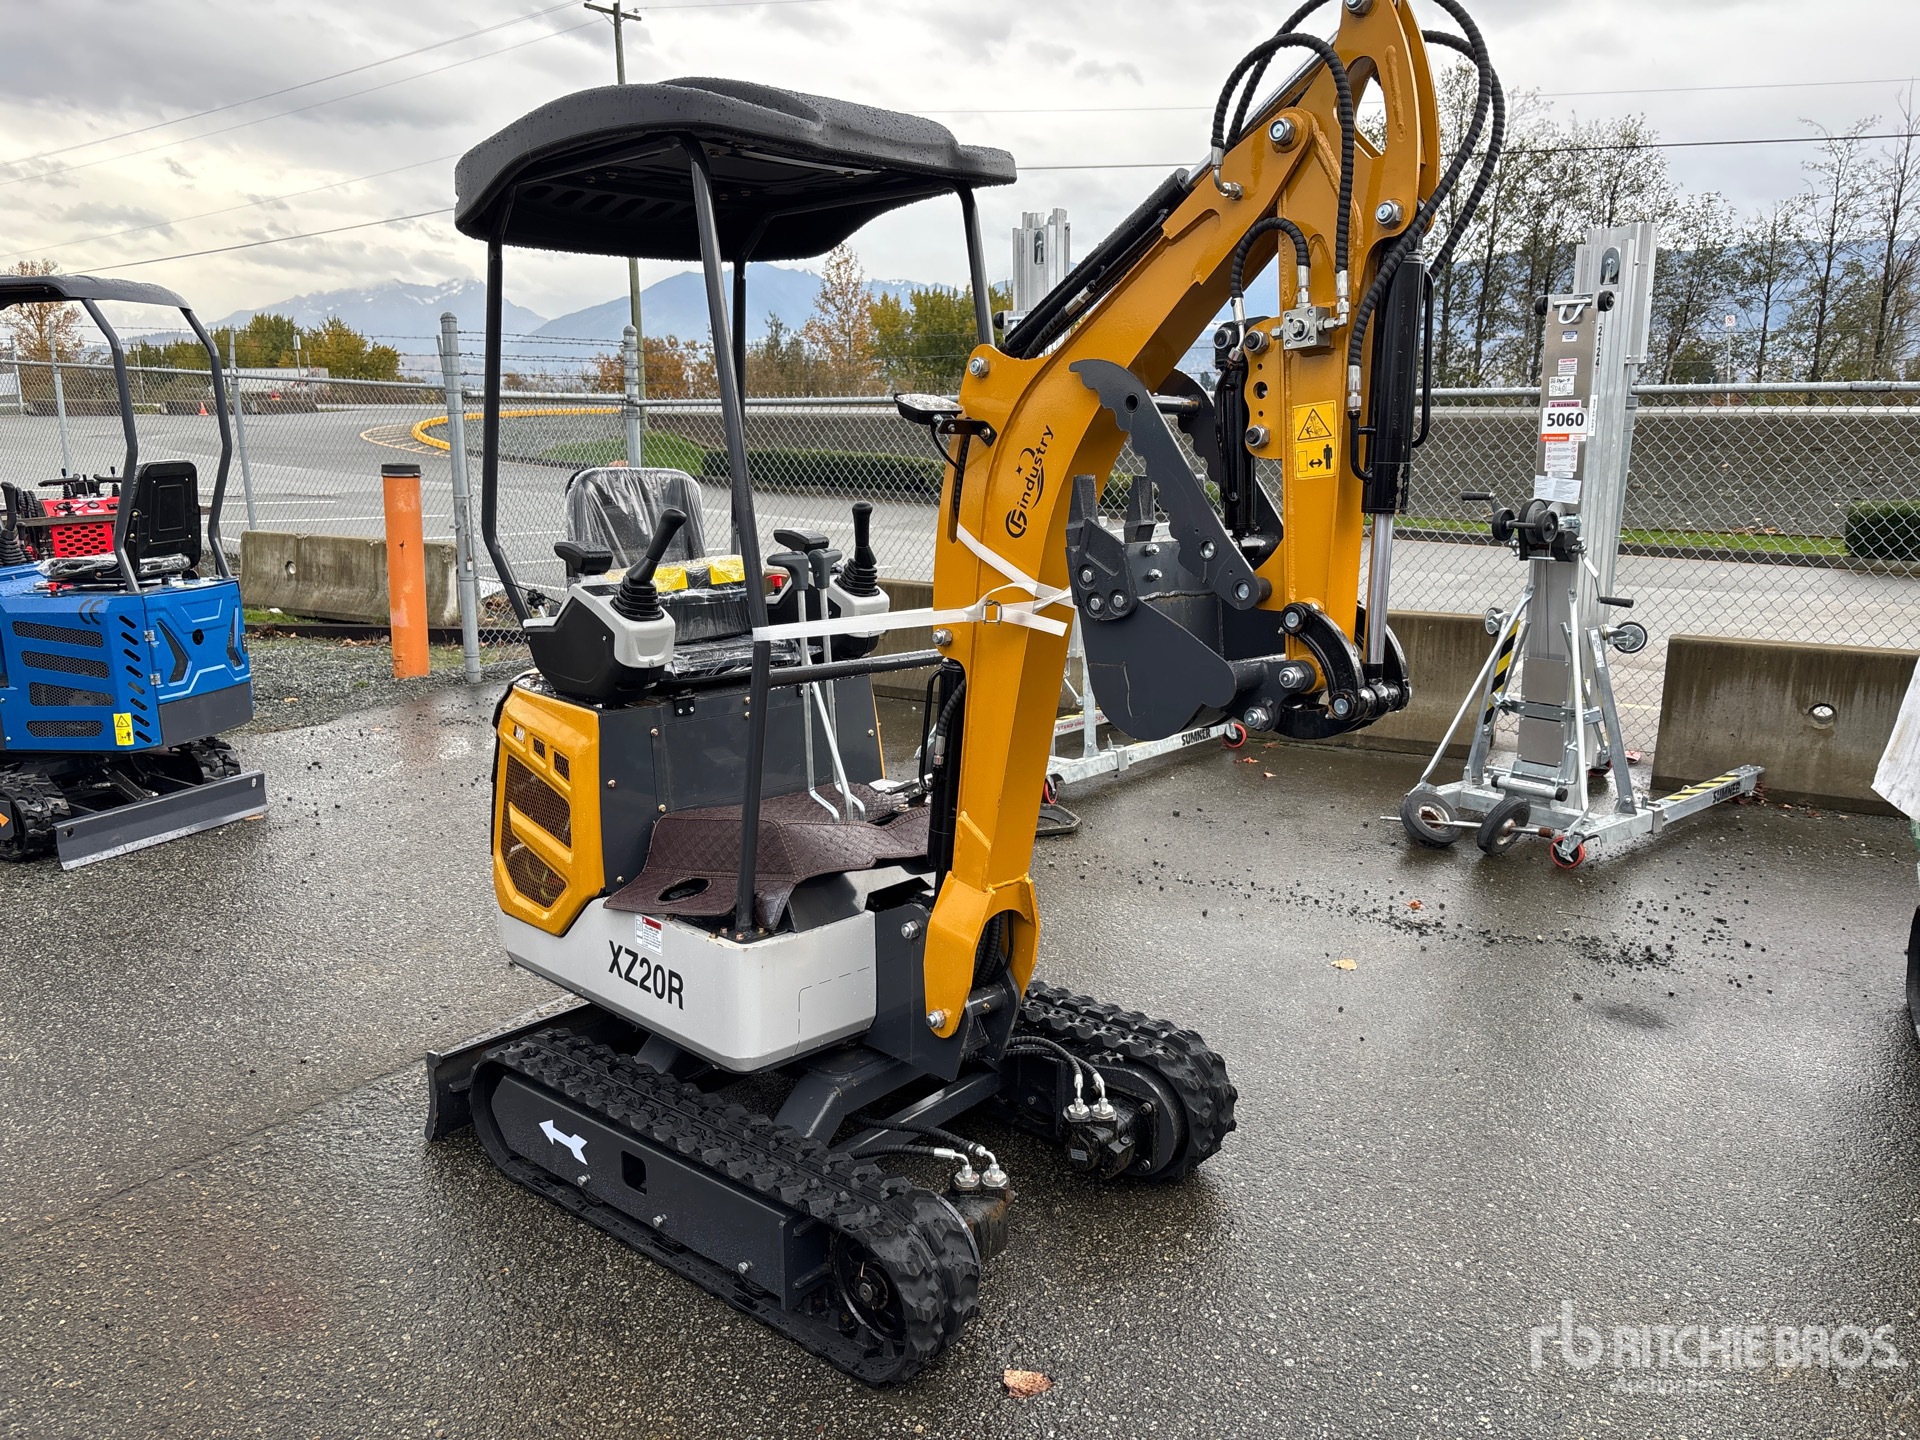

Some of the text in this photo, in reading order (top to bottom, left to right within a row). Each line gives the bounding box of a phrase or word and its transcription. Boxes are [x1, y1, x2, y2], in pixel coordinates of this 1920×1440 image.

[1595, 325, 1603, 367] 2124
[1547, 412, 1585, 427] 5060
[78, 598, 104, 625] CE
[1181, 727, 1211, 746] SUMNER
[608, 940, 684, 1010] XZ20R
